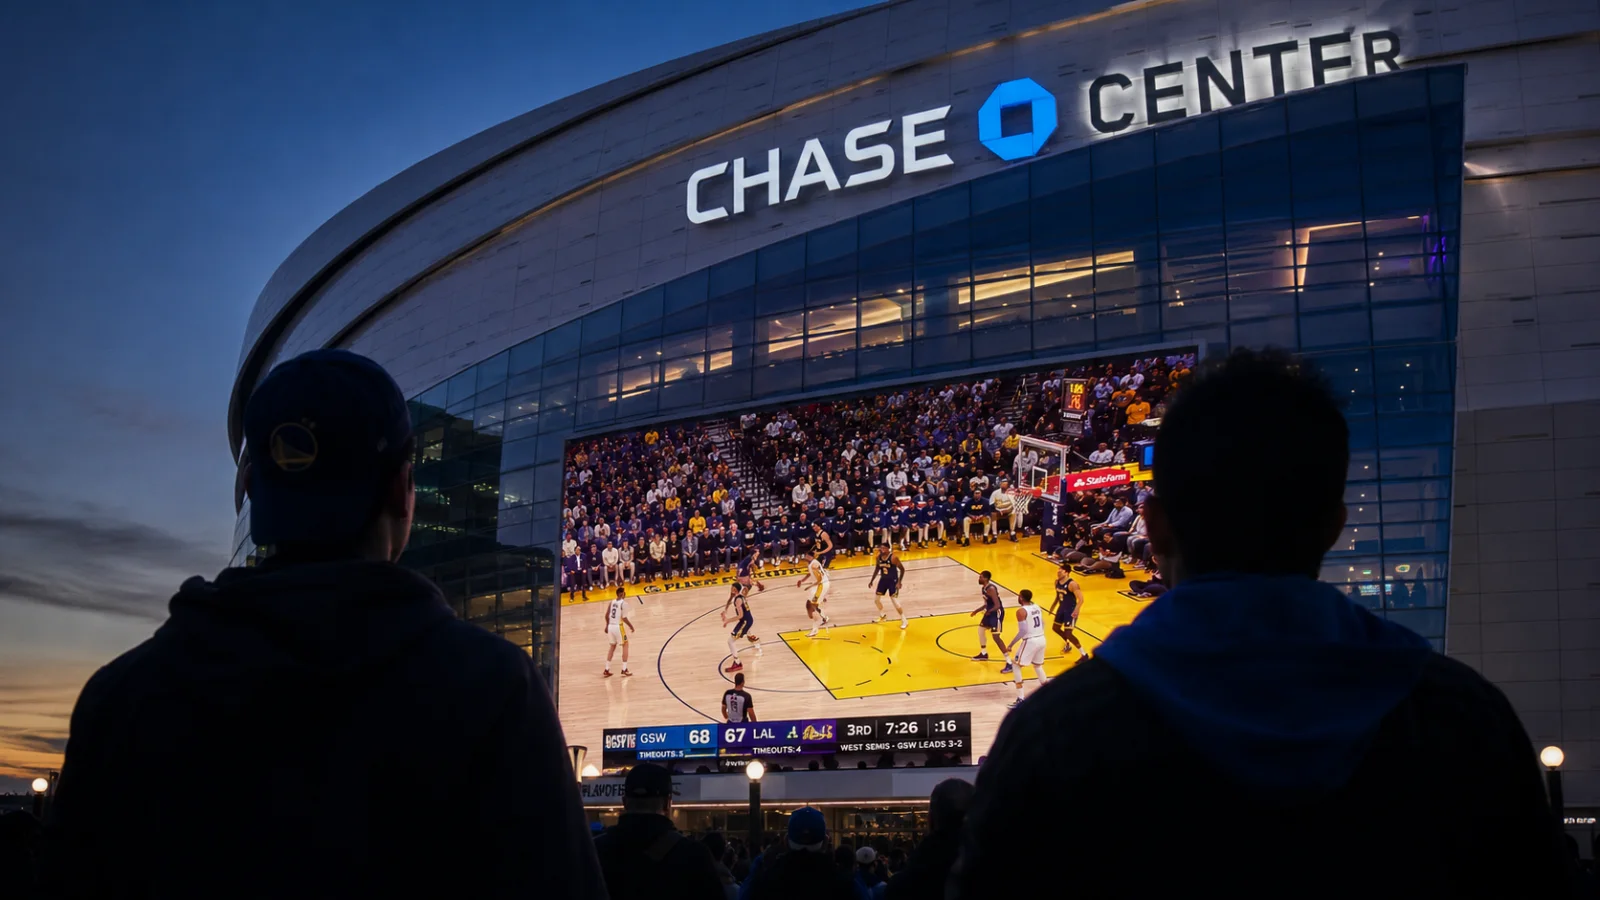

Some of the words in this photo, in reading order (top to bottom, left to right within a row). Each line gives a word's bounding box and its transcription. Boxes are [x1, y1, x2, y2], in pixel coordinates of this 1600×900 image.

[687, 105, 954, 224] CHASE
[1089, 30, 1401, 133] CENTER
[640, 732, 667, 744] GSW
[689, 729, 710, 744] 68
[725, 728, 746, 743] 67
[753, 728, 775, 739] LAL
[847, 724, 872, 736] 3RD
[885, 721, 918, 735] 7:26
[934, 720, 957, 732] :16
[918, 740, 946, 748] LEADS
[948, 739, 963, 748] 3-2
